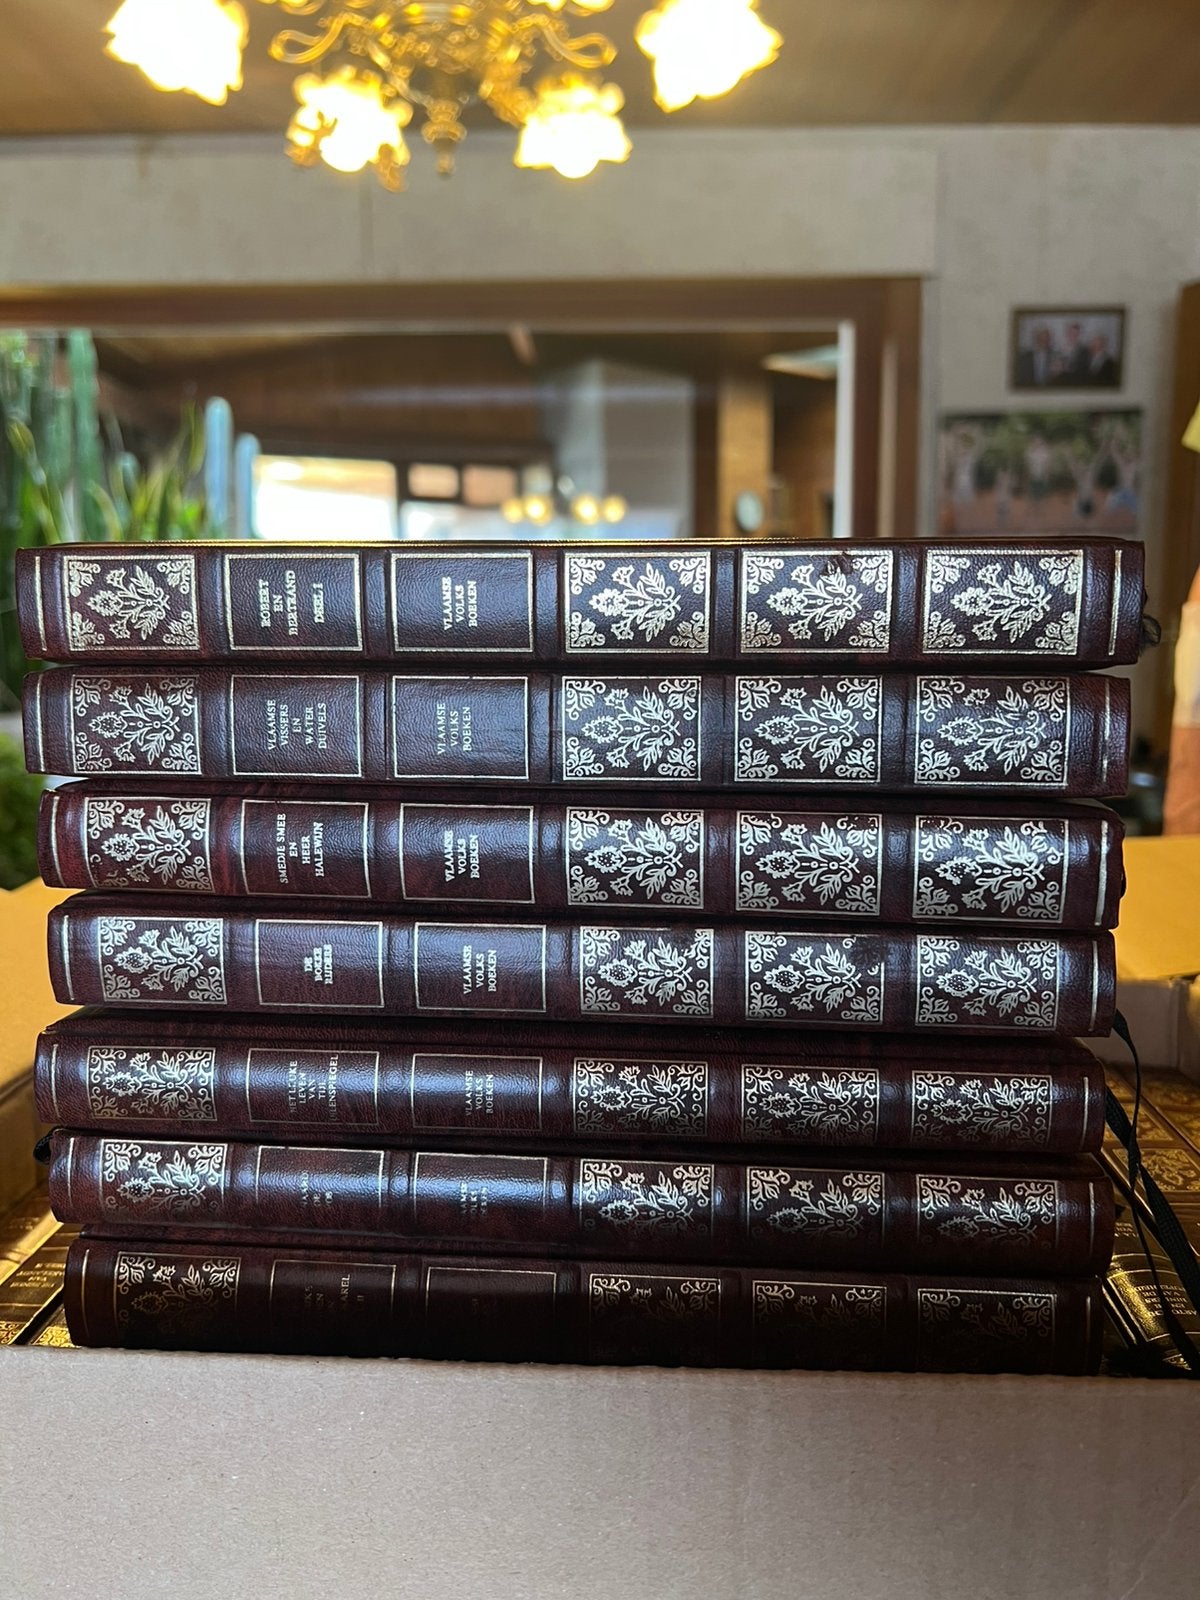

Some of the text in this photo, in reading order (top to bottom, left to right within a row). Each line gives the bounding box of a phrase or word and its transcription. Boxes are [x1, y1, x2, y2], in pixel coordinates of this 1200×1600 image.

[259, 579, 271, 628] ROBERT
[273, 594, 283, 613] EN
[285, 570, 298, 636] BERTRAND
[442, 576, 453, 631] VLAAMSE
[455, 584, 465, 623] VOLKS
[467, 580, 478, 628] BOEKEN
[267, 699, 276, 750] VLAAMSE
[280, 704, 289, 746] VISSERS
[292, 718, 302, 733] EN
[305, 707, 314, 745] WATER
[318, 702, 327, 749] DUIVELS
[437, 702, 446, 755] VLAAMSE
[450, 710, 459, 747] VOLKS
[462, 707, 472, 751] BOEKEN
[276, 813, 286, 843] SMEE
[289, 842, 298, 857] EN
[301, 835, 311, 864] HEER
[444, 830, 455, 882] VLAAMSE
[457, 838, 467, 875] VOLKS
[469, 834, 480, 879] BOEKEN
[463, 945, 472, 995] VLAAMSE
[475, 953, 485, 988] VOLKS
[487, 949, 497, 992] BOEKEN
[288, 1060, 298, 1113] HET LEUKE
[298, 1072, 307, 1104] LEVEN
[308, 1079, 316, 1099] VAN
[318, 1081, 327, 1100] TIJL
[328, 1054, 339, 1121] UILENSPIEGEL
[465, 1070, 474, 1116] VLAAMSE
[475, 1078, 484, 1110] VOLKS
[486, 1074, 494, 1114] BOEKEN
